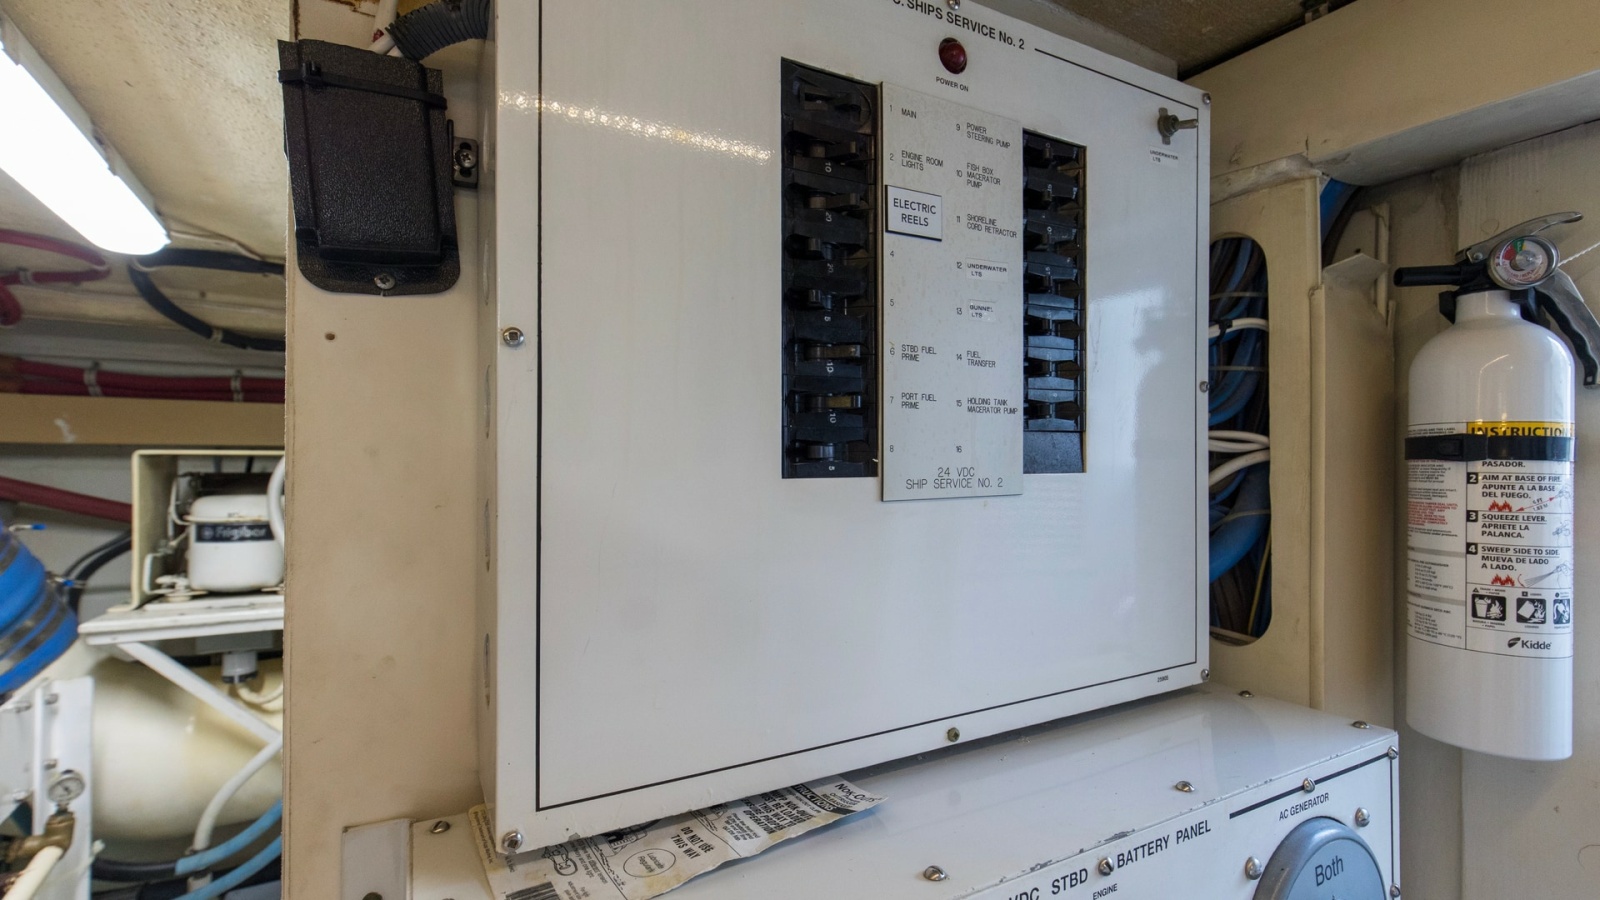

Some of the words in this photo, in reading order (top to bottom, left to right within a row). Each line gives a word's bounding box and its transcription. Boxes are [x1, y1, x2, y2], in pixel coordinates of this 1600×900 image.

[907, 0, 943, 20] SHIPS
[946, 11, 996, 39] SERVICE
[999, 30, 1016, 46] No.
[1019, 38, 1025, 50] 2
[936, 76, 959, 89] POWER
[960, 84, 969, 92] ON
[902, 108, 917, 119] MAIN
[966, 123, 987, 134] POWER
[967, 131, 994, 145] STEERING
[996, 139, 1011, 149] PUMP
[890, 153, 894, 161] 2
[902, 150, 923, 162] ENGINE
[926, 156, 944, 168] ROOM
[1150, 150, 1178, 160] UNDERWATER
[902, 160, 924, 171] LIGHTS
[967, 162, 980, 171] FISH
[982, 166, 994, 175] BOX
[967, 172, 1001, 185] MACERATOR
[967, 180, 982, 189] PUMP
[893, 198, 936, 215] ELECTRIC
[901, 213, 929, 227] REELS
[967, 214, 997, 226] SHORELINE
[967, 223, 982, 232] CORD
[984, 224, 1017, 238] RETRACTOR
[967, 263, 1007, 272] UNDERWATER
[902, 344, 919, 353] STBD
[921, 346, 937, 355] FUEL
[967, 351, 981, 359] FUEL
[902, 354, 920, 362] PRIME
[968, 359, 996, 368] TRANSFER
[902, 393, 918, 401] PORT
[921, 393, 937, 402] FUEL
[967, 398, 991, 406] HOLDING
[902, 402, 920, 410] PRIME
[967, 406, 1001, 414] MACERATOR
[938, 468, 950, 478] 24
[957, 467, 975, 477] VDC
[906, 479, 928, 490] SHIP
[934, 478, 972, 489] SERVICE
[978, 478, 992, 488] NO.
[997, 478, 1004, 488] 2
[1469, 512, 1476, 521] 3
[1482, 523, 1515, 531] APRIETE
[1482, 531, 1525, 539] PALANCA.
[1468, 545, 1476, 554] 4
[1482, 546, 1510, 554] SWEEP
[1482, 556, 1513, 564] MUEVA
[1522, 640, 1551, 650] Kidde
[758, 802, 776, 814] THIS
[771, 813, 787, 823] WAY
[1279, 809, 1289, 822] AC
[1290, 792, 1329, 818] GENERATOR
[743, 810, 778, 834] OPERATION
[681, 826, 694, 835] DO
[687, 834, 704, 846] NOT
[1117, 835, 1170, 868] BATTERY
[1176, 820, 1212, 845] PANEL
[671, 834, 688, 849] THIS
[683, 847, 701, 859] WAY
[698, 843, 714, 853] USE
[1315, 855, 1344, 887] Both
[1052, 868, 1088, 895] STBD
[1093, 883, 1118, 900] ENGINE
